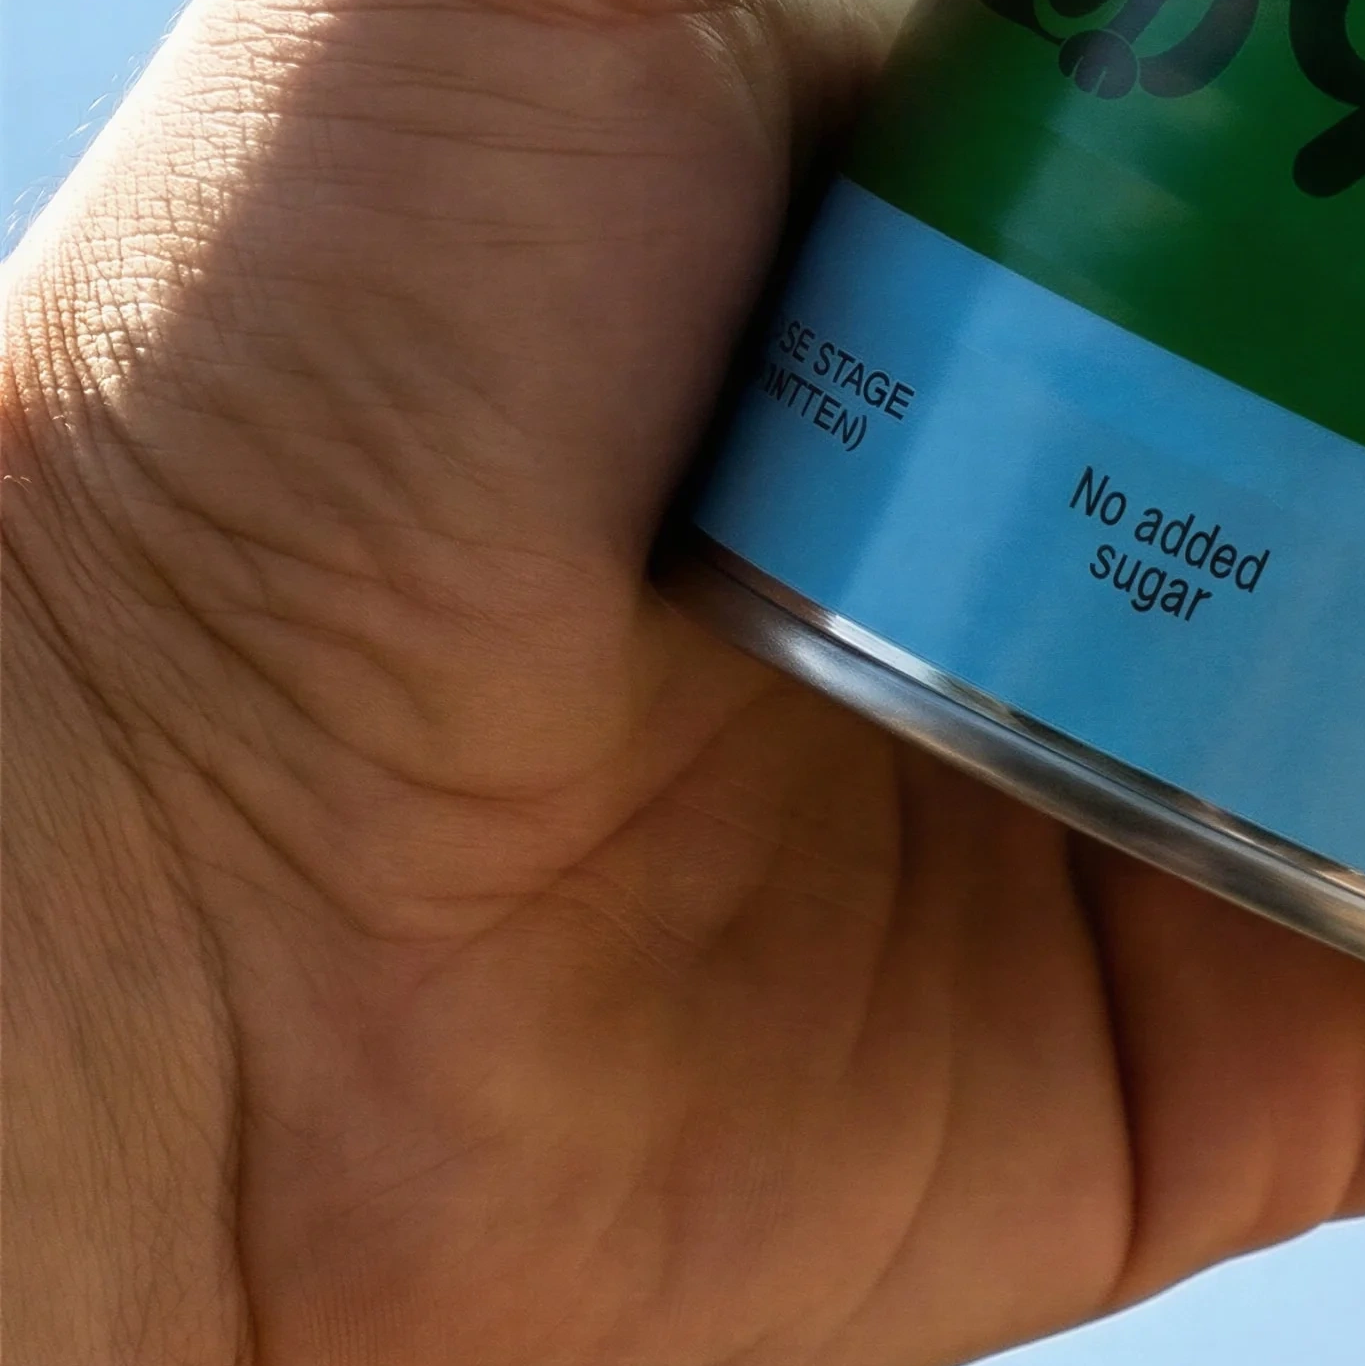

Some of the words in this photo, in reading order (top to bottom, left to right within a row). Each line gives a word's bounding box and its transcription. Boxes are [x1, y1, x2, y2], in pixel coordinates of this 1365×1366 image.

[813, 342, 915, 421] STAGE
[1069, 465, 1127, 525] No
[1134, 507, 1270, 593] added
[1089, 544, 1213, 622] sugar
